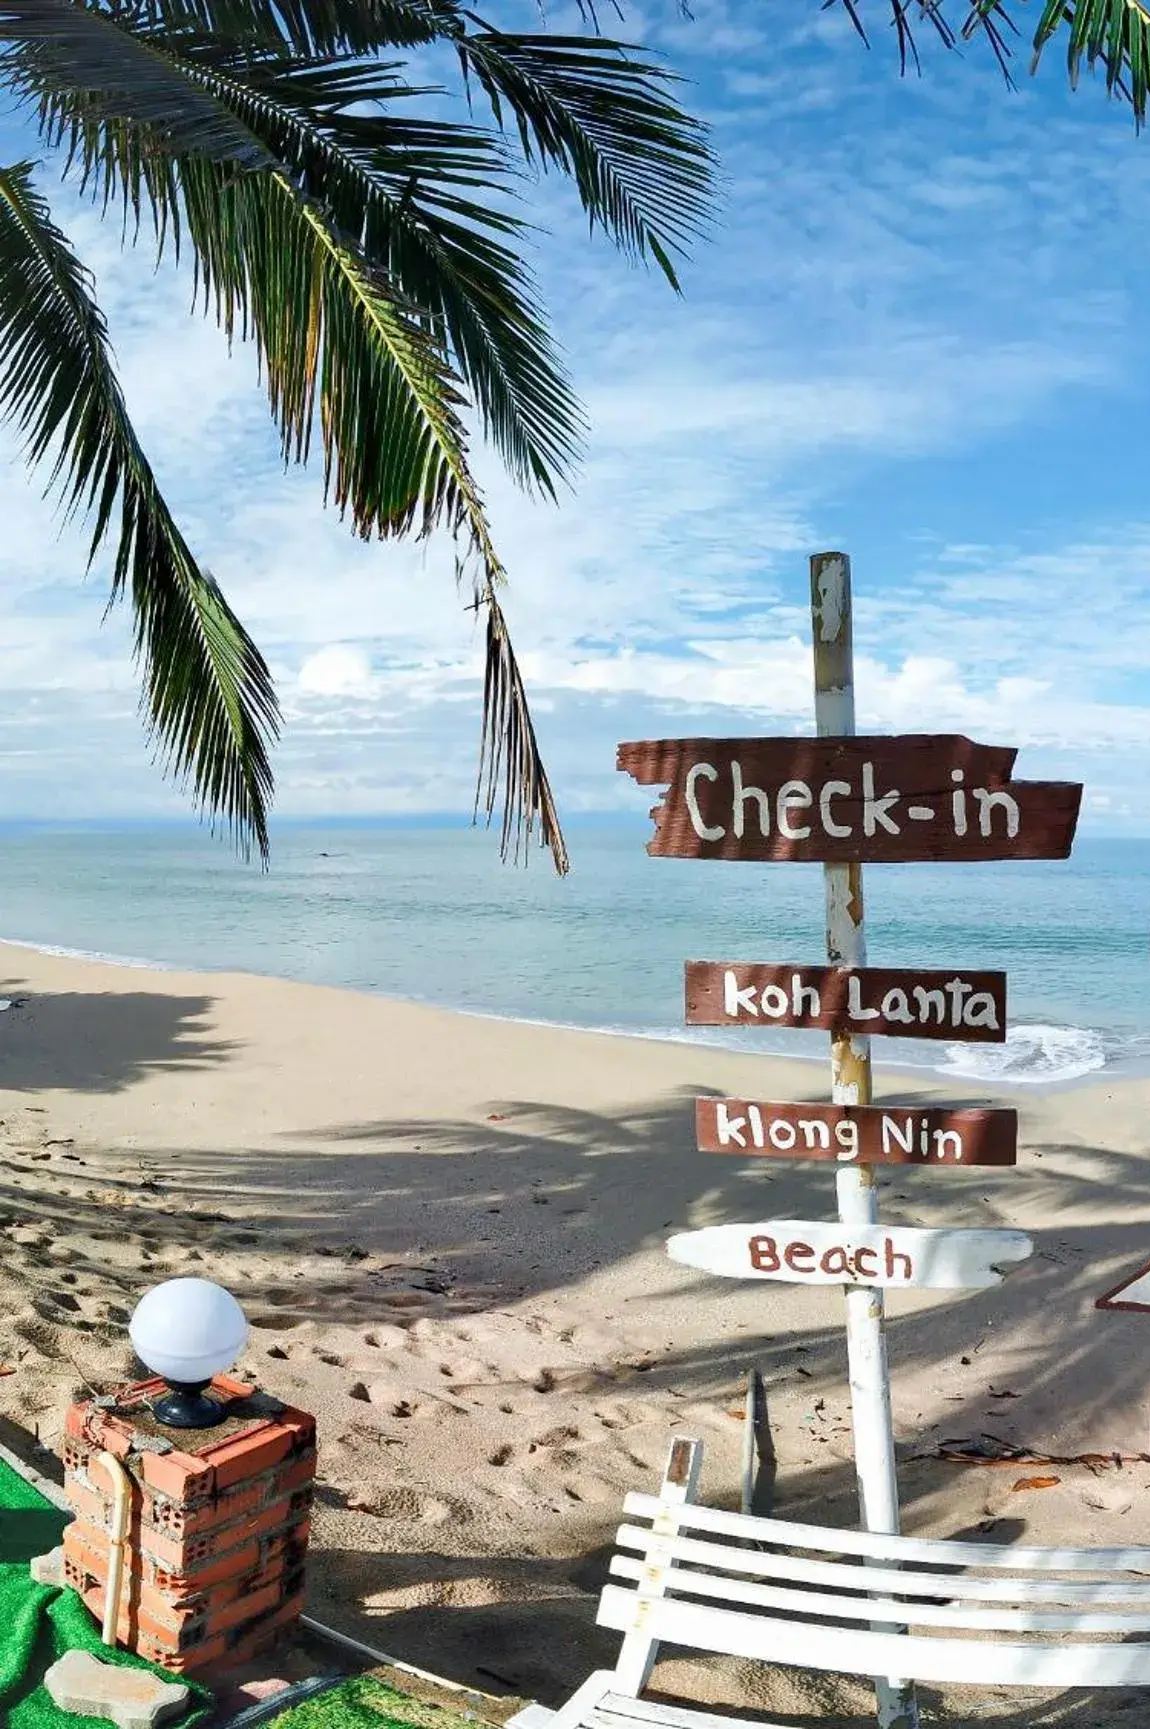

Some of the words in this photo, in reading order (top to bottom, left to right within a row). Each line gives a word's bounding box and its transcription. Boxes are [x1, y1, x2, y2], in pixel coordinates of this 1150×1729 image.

[685, 761, 1020, 842] Check-in
[848, 976, 1000, 1030] Lanta
[881, 1115, 963, 1160] Nin
[748, 1234, 913, 1280] Beach
